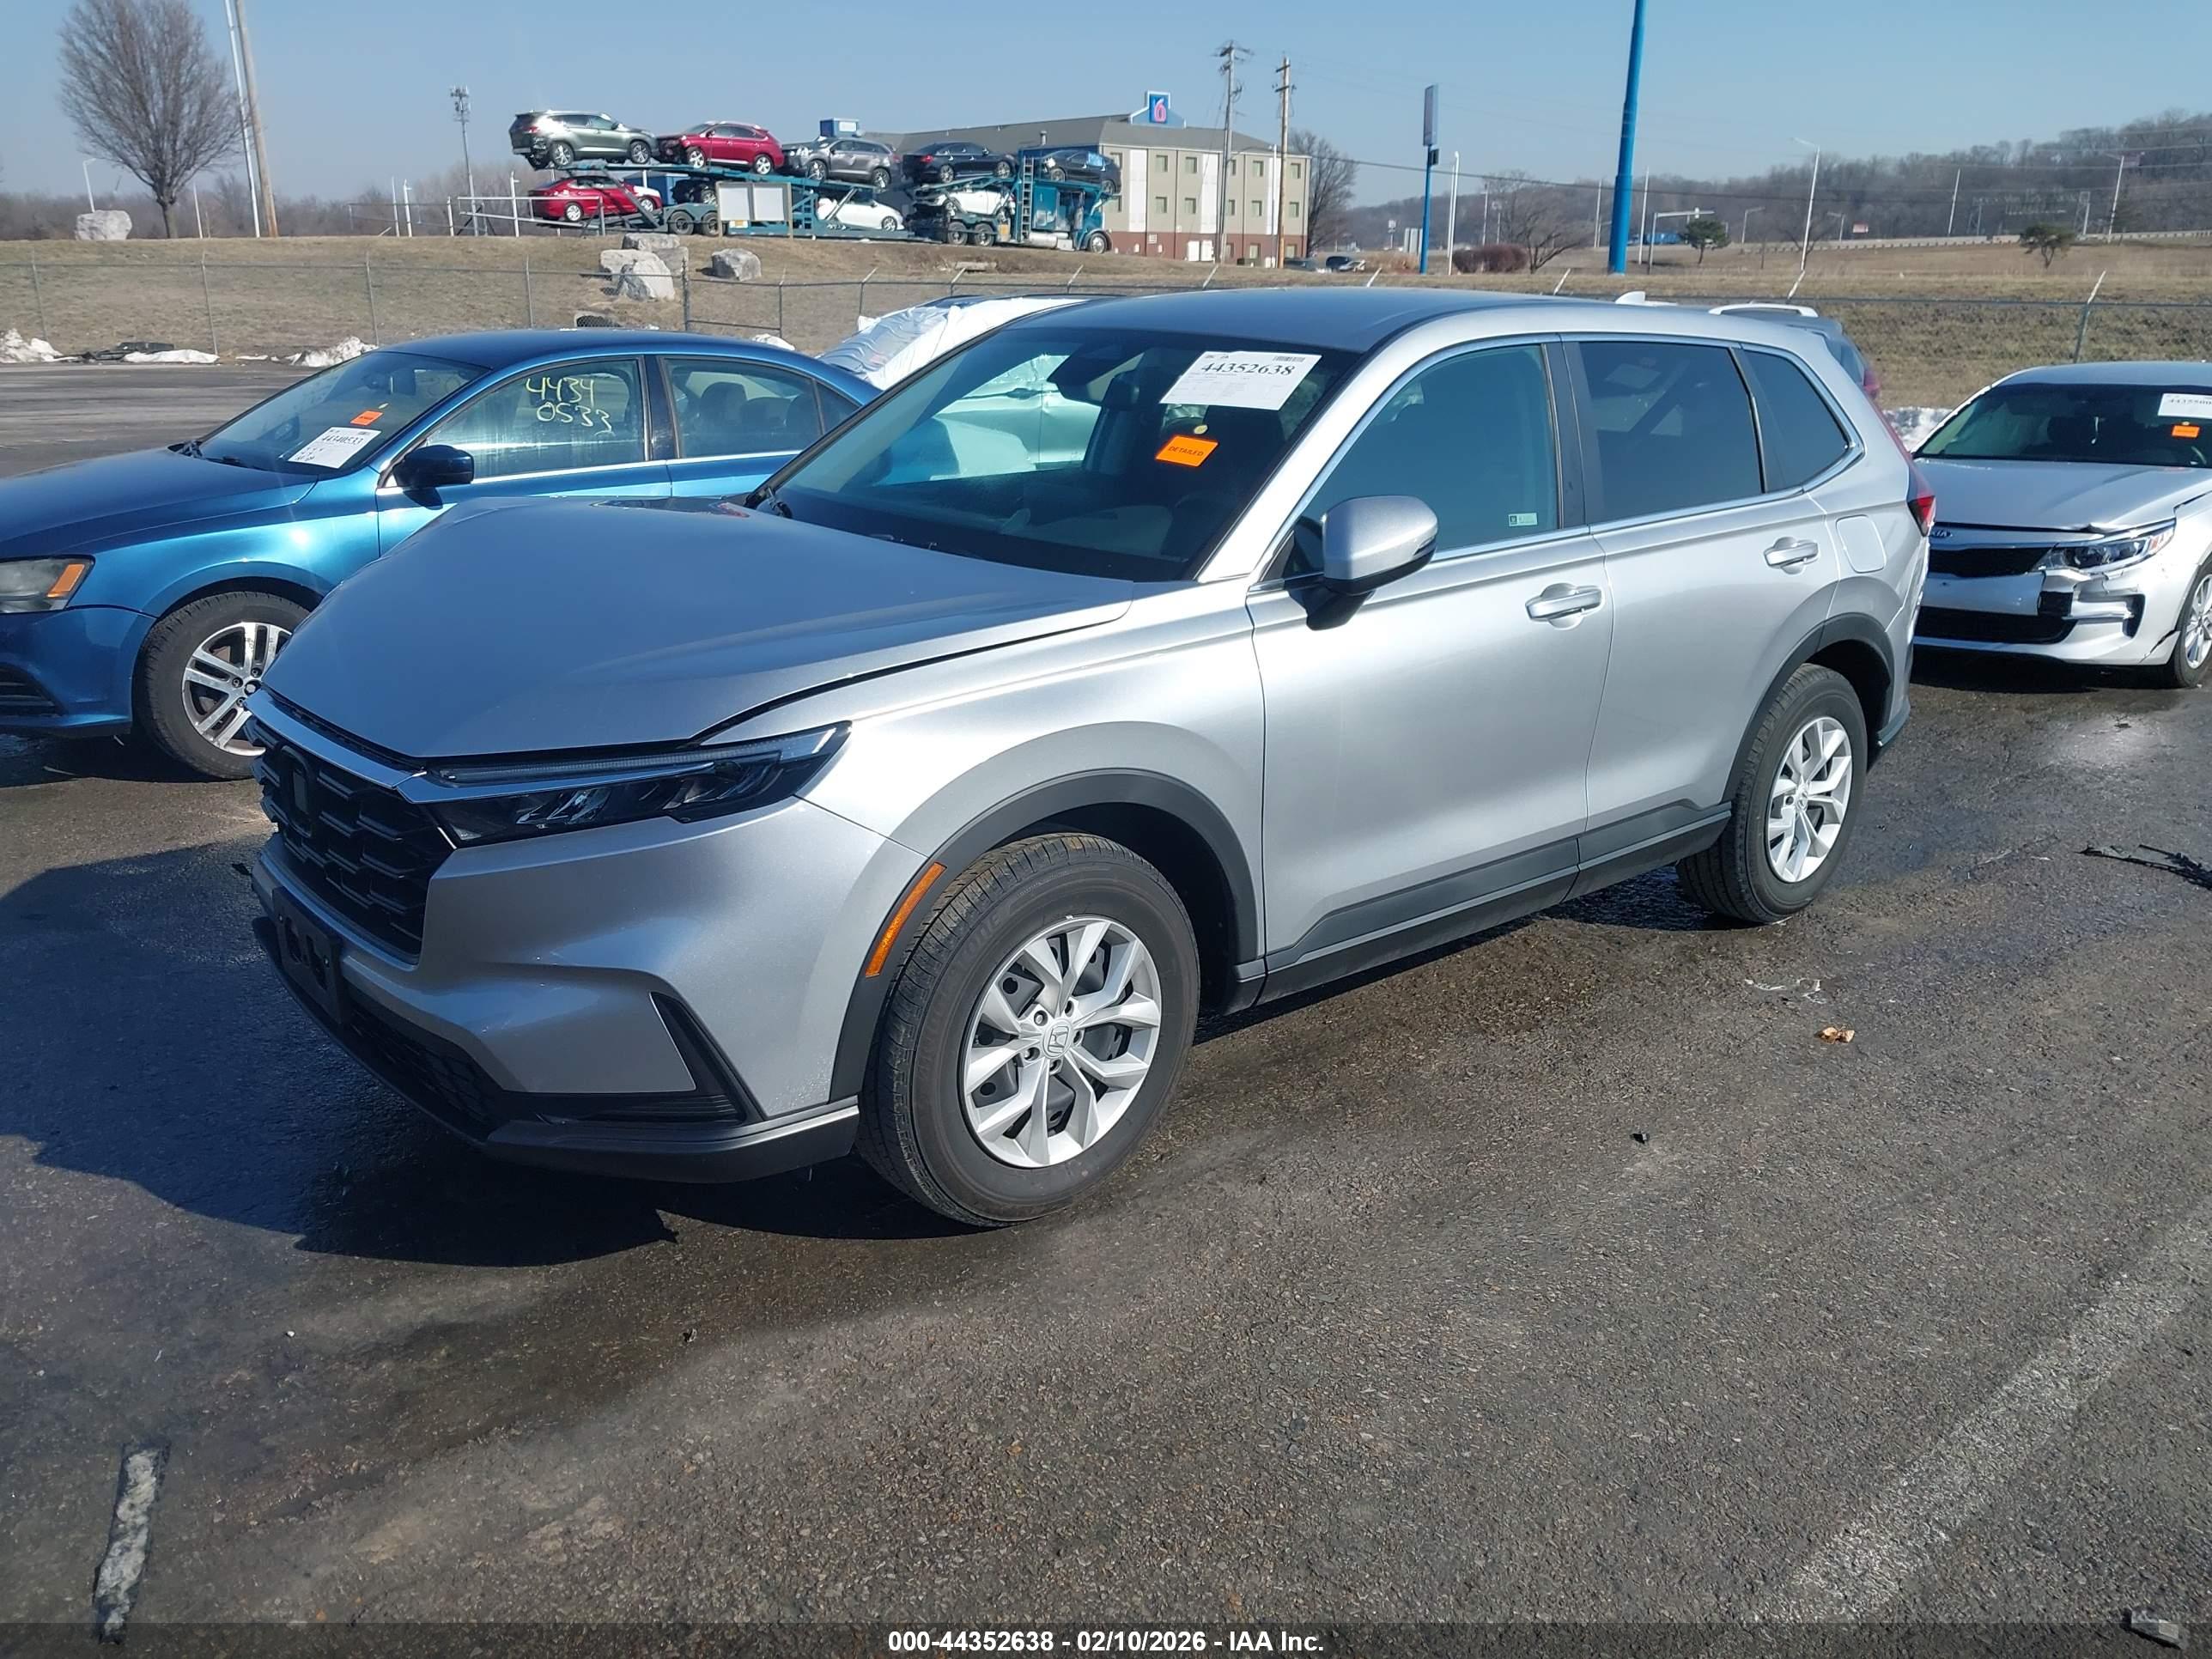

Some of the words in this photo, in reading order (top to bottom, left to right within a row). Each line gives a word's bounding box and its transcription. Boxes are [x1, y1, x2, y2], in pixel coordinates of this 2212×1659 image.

[1154, 97, 1167, 124] 6
[1201, 362, 1296, 376] 44352638
[526, 377, 595, 408] 4434
[1168, 446, 1204, 456] DETAILED
